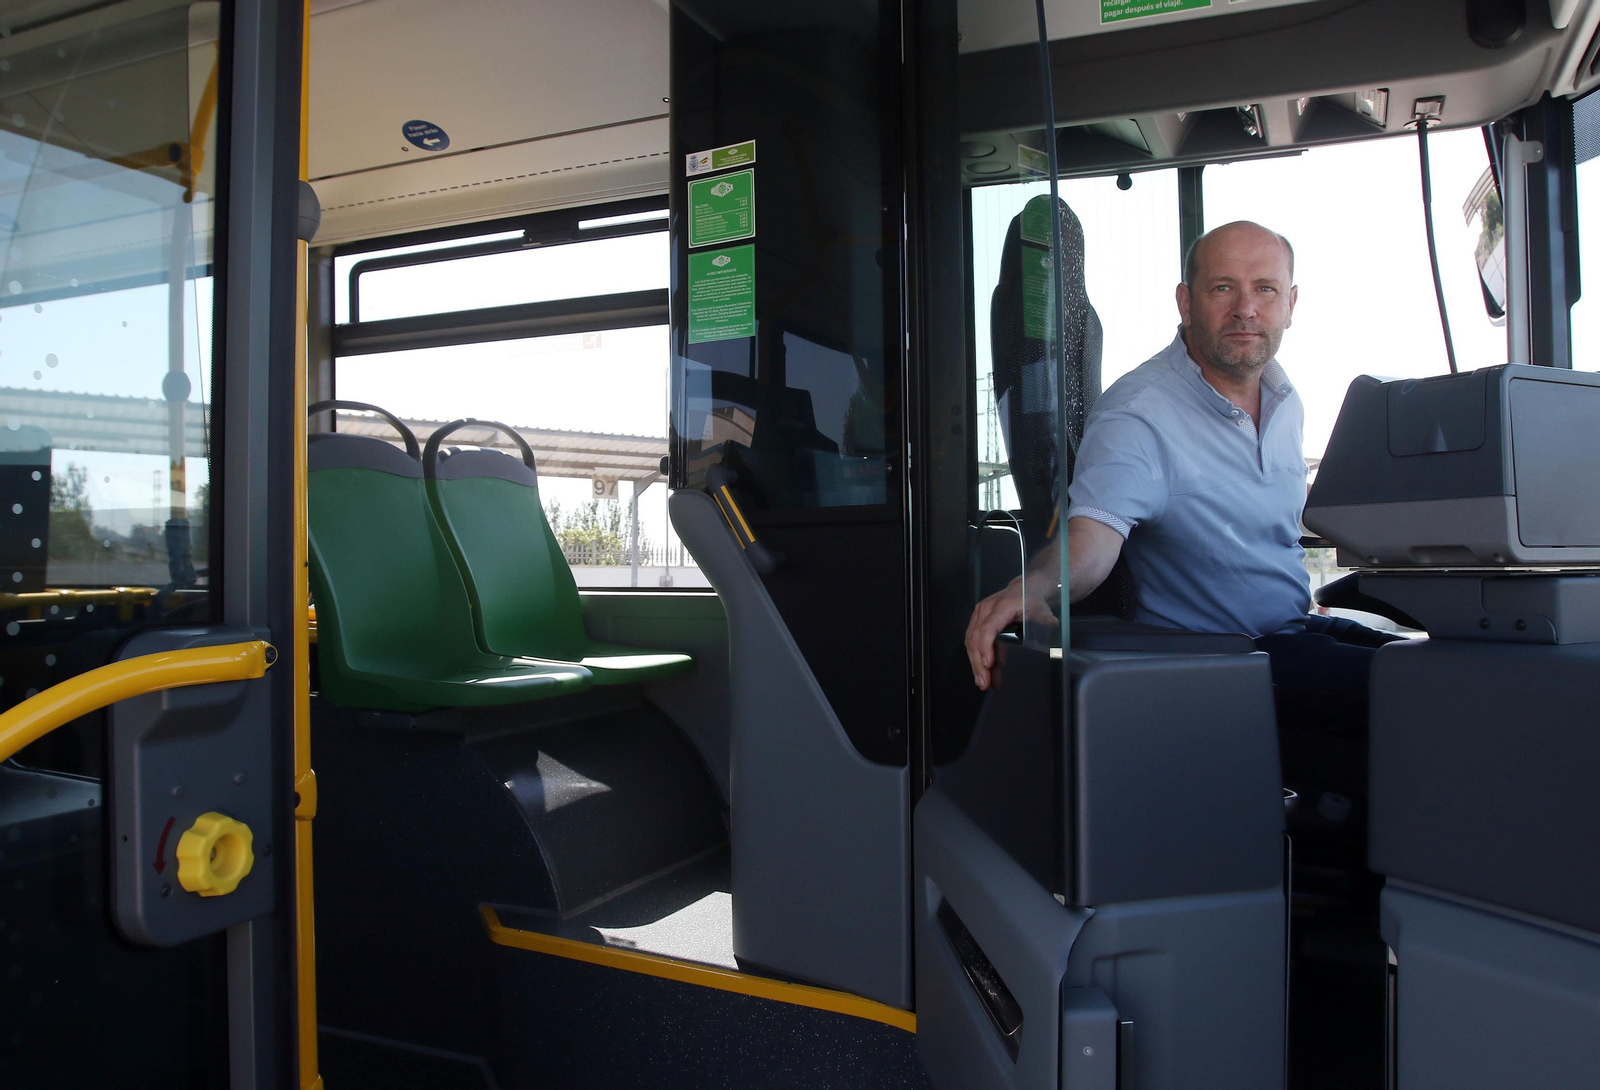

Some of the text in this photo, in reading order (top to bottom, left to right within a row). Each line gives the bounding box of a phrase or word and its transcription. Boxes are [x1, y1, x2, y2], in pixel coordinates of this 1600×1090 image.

[1104, 9, 1123, 18] pagar
[1125, 3, 1154, 13] después
[1155, 1, 1162, 9] el
[594, 479, 617, 496] 97
